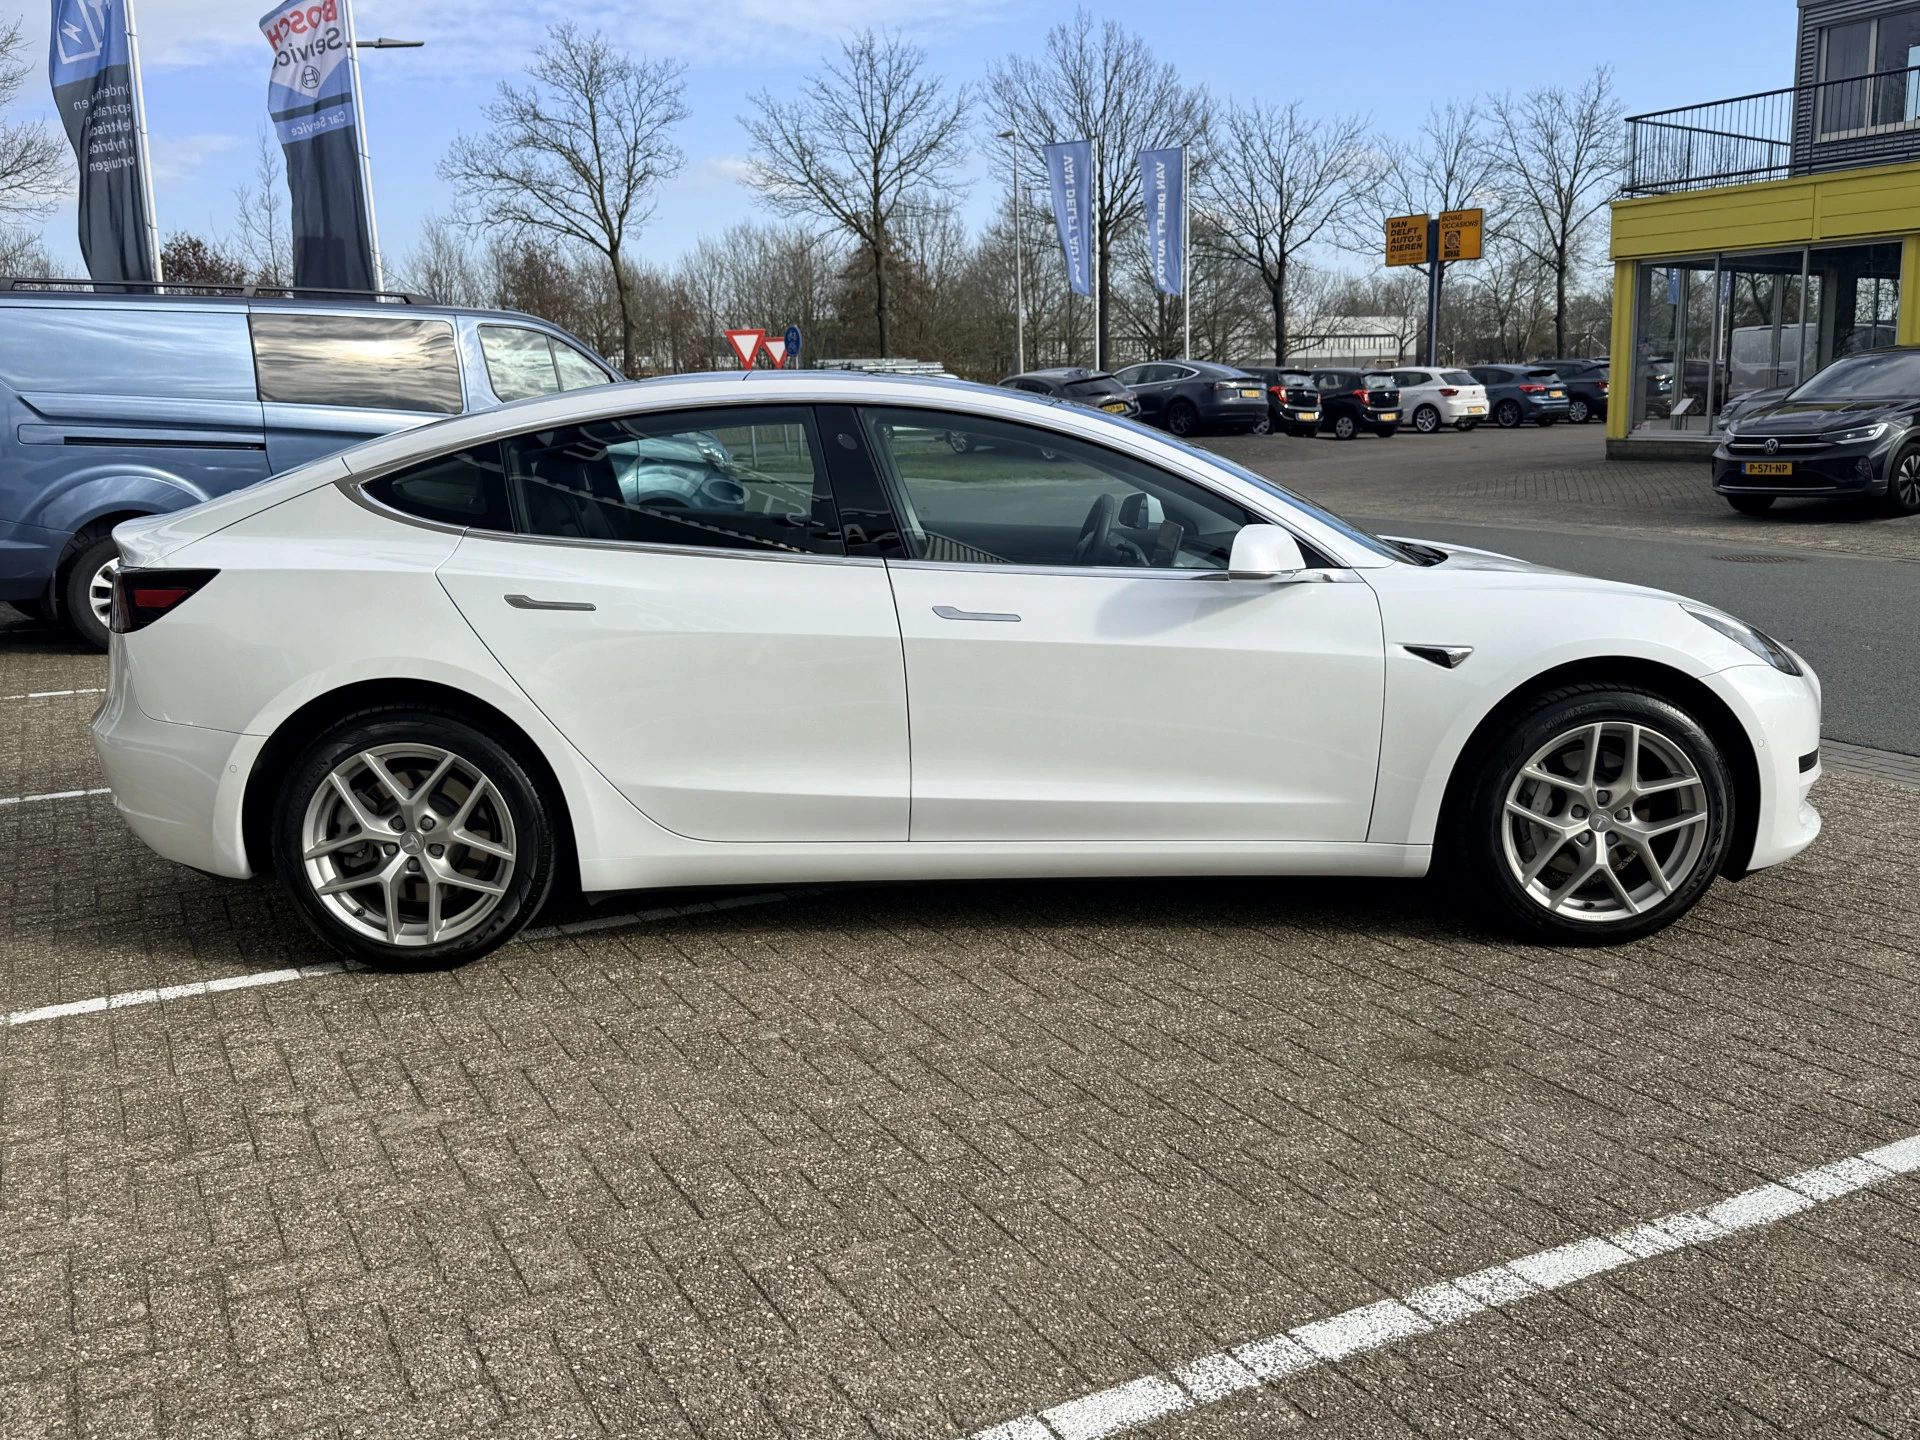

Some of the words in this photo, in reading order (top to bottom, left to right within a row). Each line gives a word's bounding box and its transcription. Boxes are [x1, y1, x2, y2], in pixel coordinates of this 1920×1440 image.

[1442, 220, 1478, 229] OCCASIONS
[1390, 227, 1419, 236] DELFT
[1390, 235, 1422, 244] AUTO'S
[1390, 243, 1423, 252] DIEREN
[1750, 464, 1788, 473] P-571-NP
